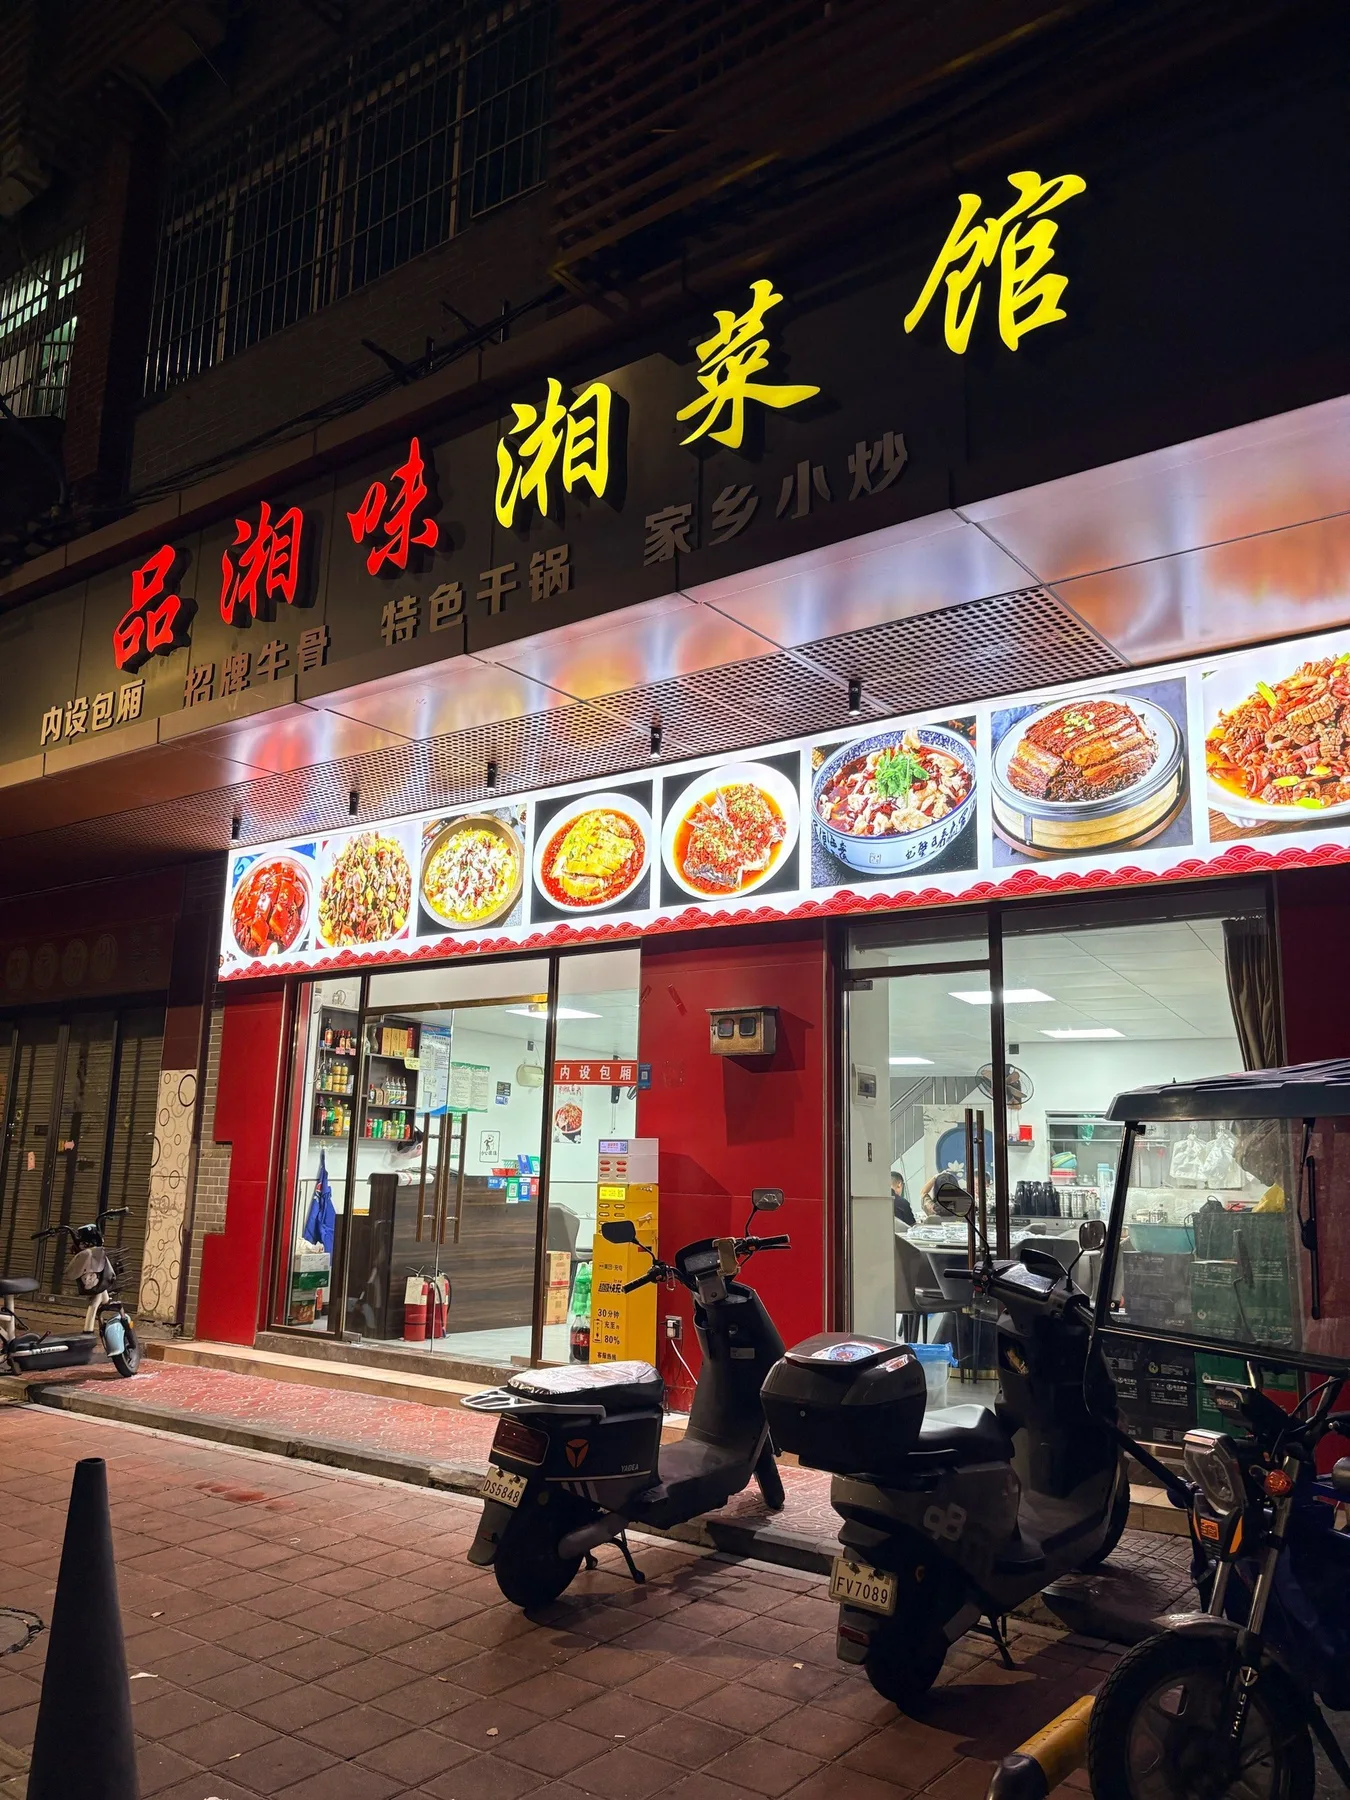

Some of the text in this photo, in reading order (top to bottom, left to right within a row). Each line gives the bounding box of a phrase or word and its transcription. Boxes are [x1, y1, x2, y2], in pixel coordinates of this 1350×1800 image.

[112, 171, 1087, 670] 品湘味湘菜馆
[41, 431, 908, 745] 内设包厢 招牌牛骨 特色干锅 家乡小炒
[560, 1065, 632, 1080] 内设包厢
[597, 1308, 620, 1318] 30分钟
[604, 1335, 620, 1345] 80%
[483, 1479, 521, 1503] DS5848
[836, 1577, 888, 1604] FV7089
